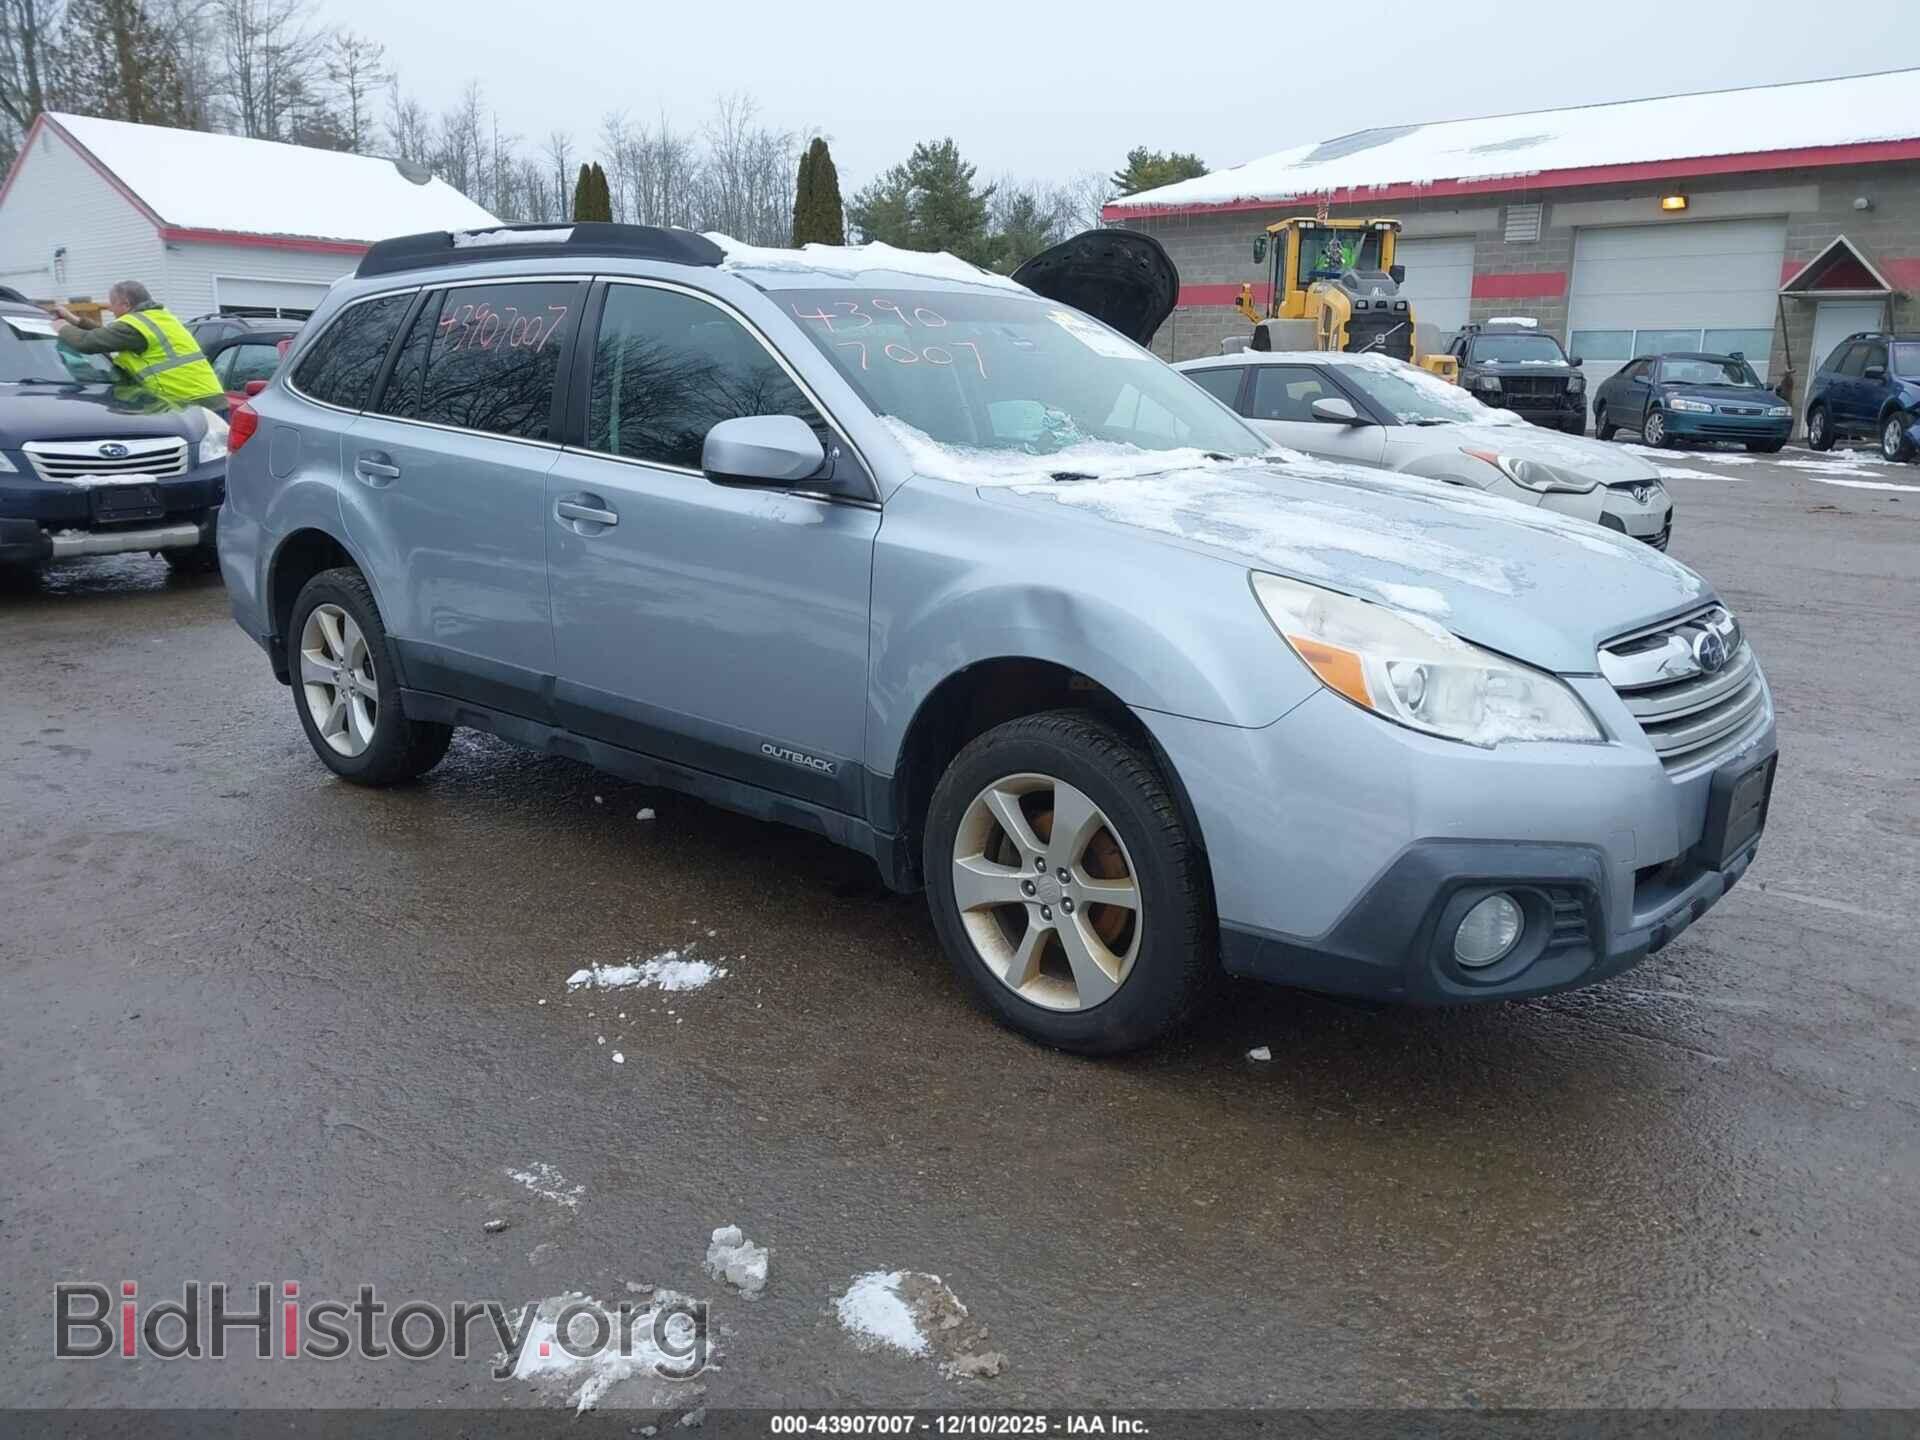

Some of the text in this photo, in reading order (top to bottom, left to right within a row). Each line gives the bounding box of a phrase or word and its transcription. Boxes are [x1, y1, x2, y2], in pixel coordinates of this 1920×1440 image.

[440, 300, 567, 361] 43907007
[792, 299, 947, 333] 4390
[836, 341, 988, 379] 7007
[761, 743, 834, 774] OUTBACK
